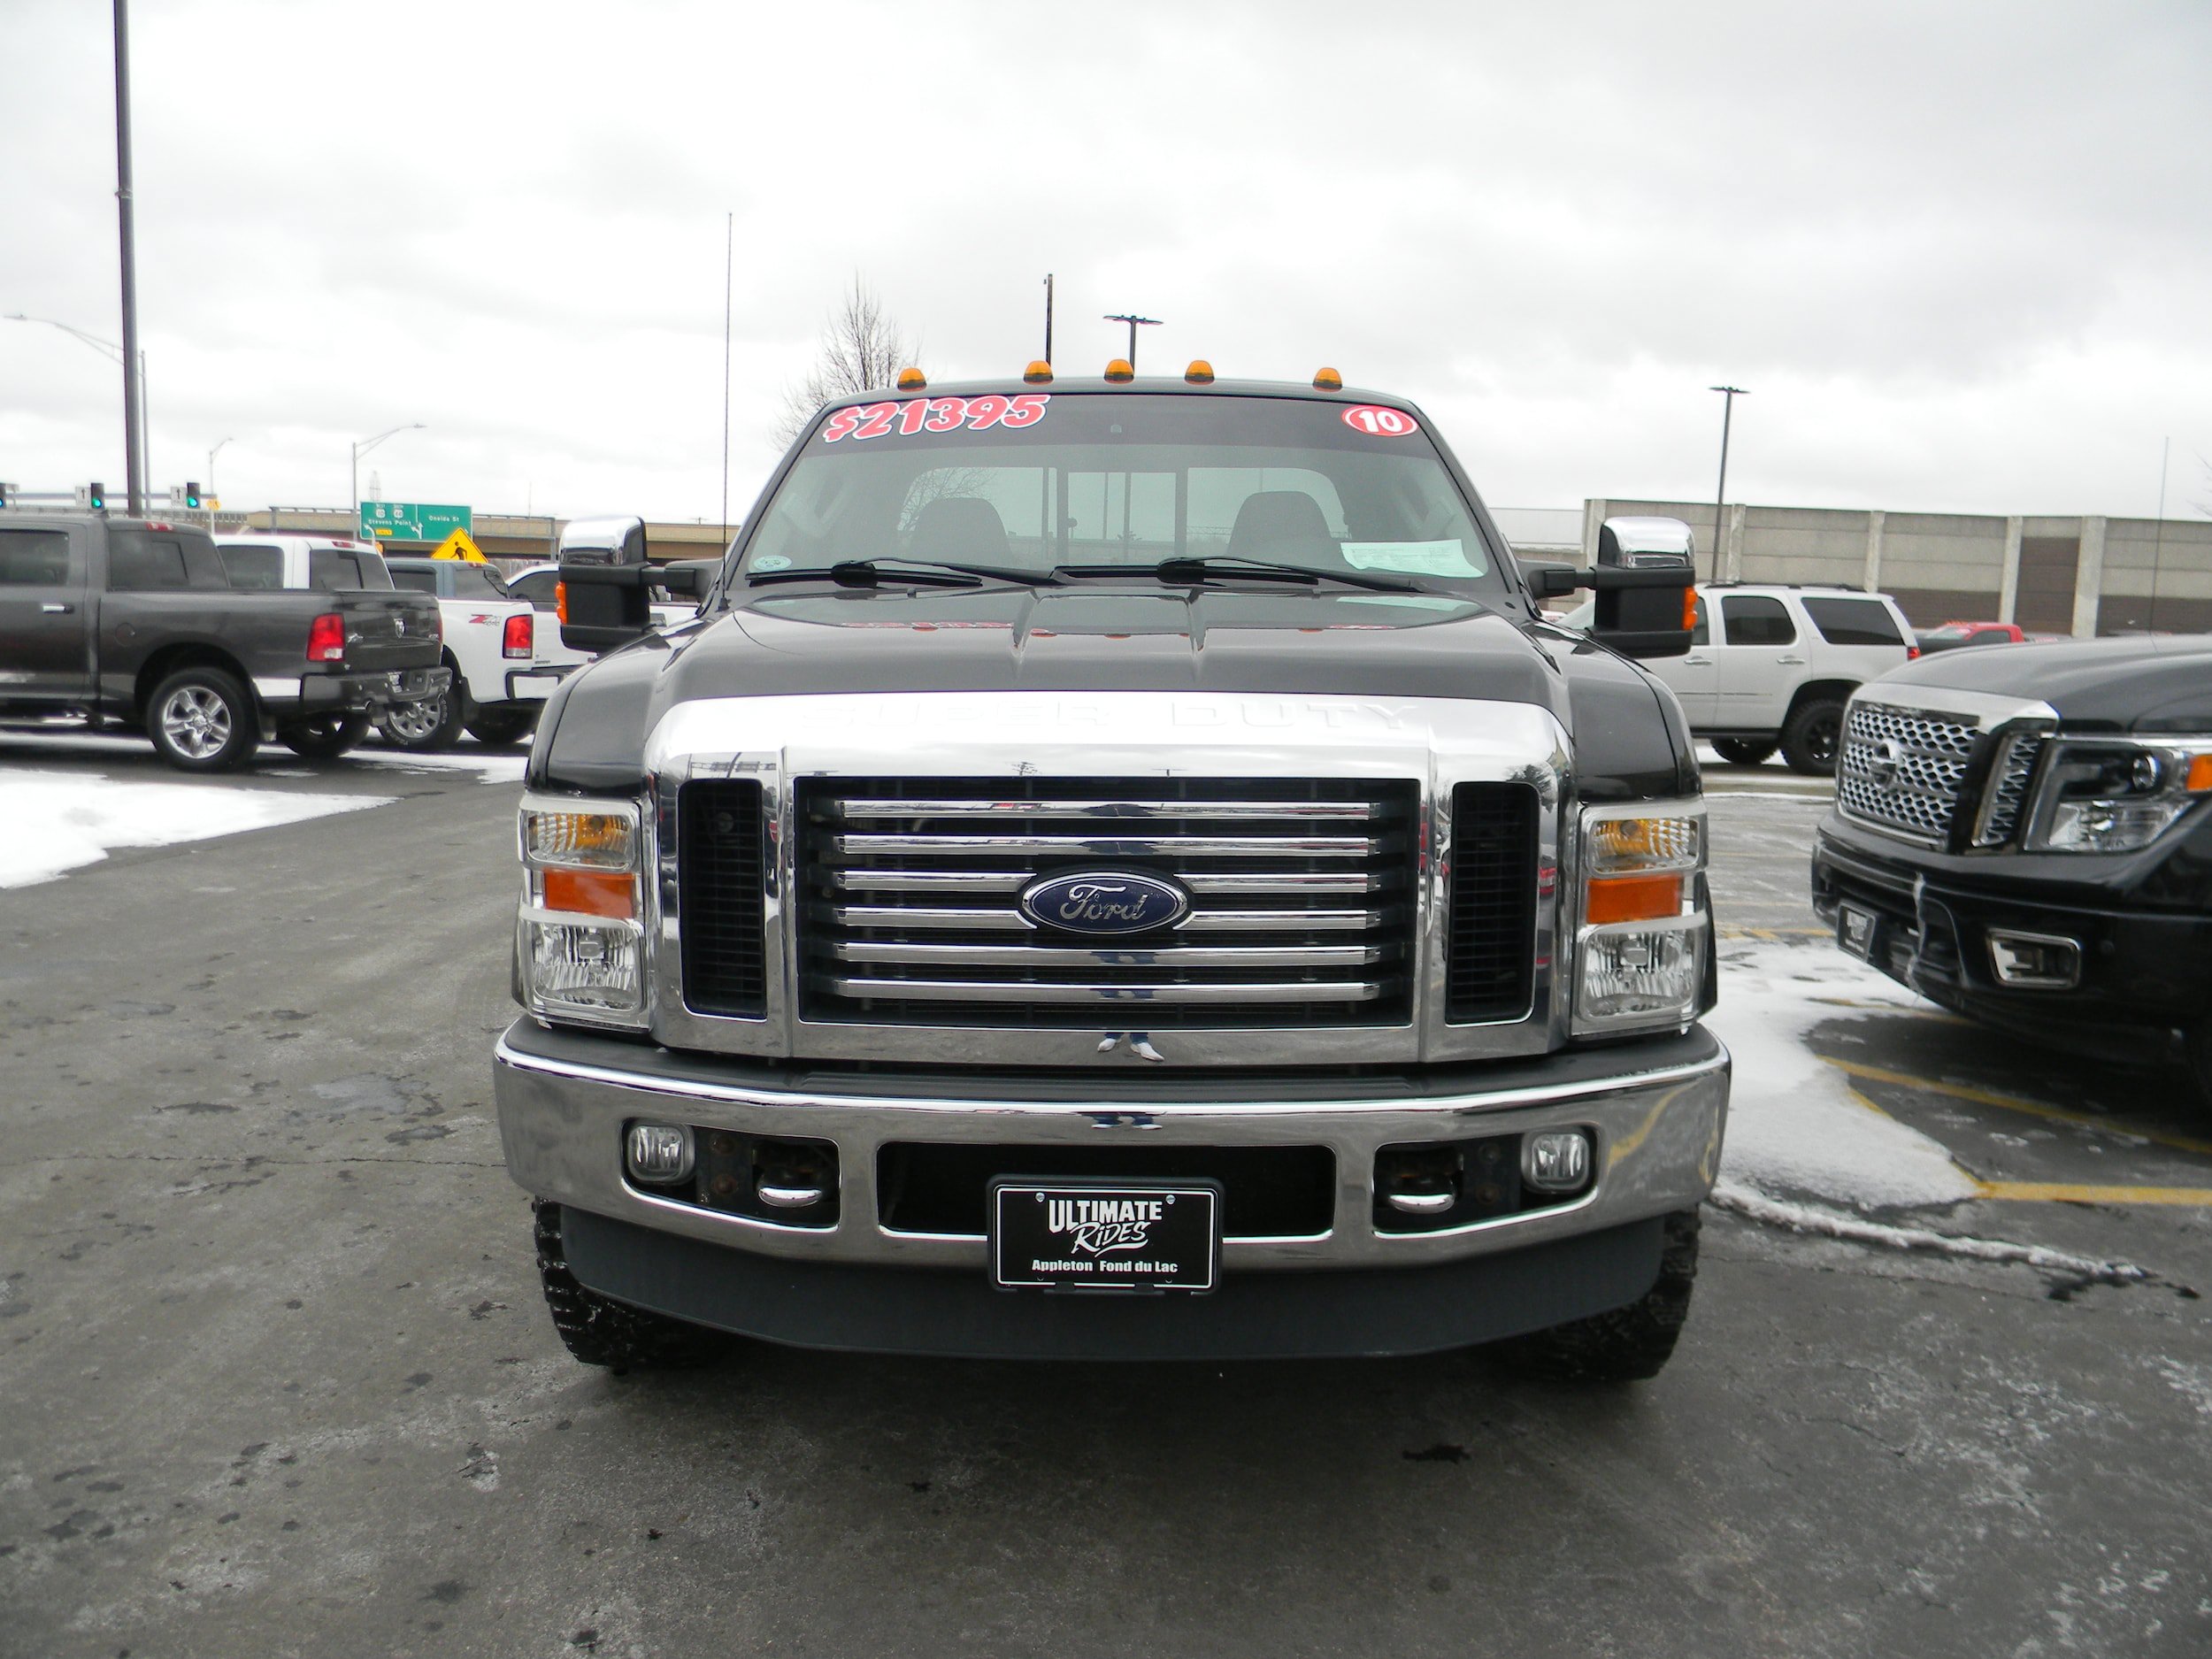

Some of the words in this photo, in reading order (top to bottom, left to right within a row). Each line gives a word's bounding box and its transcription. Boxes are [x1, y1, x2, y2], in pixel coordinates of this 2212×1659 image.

[822, 395, 1052, 443] $21395
[1358, 410, 1403, 433] 10
[1171, 701, 1419, 730] DUTY
[1059, 884, 1148, 920] Ford
[1048, 1199, 1163, 1233] ULTIMATE
[1032, 1259, 1094, 1272] Appleton
[1100, 1260, 1133, 1272] Fond
[1134, 1261, 1152, 1272] du
[1155, 1261, 1179, 1273] Lac
